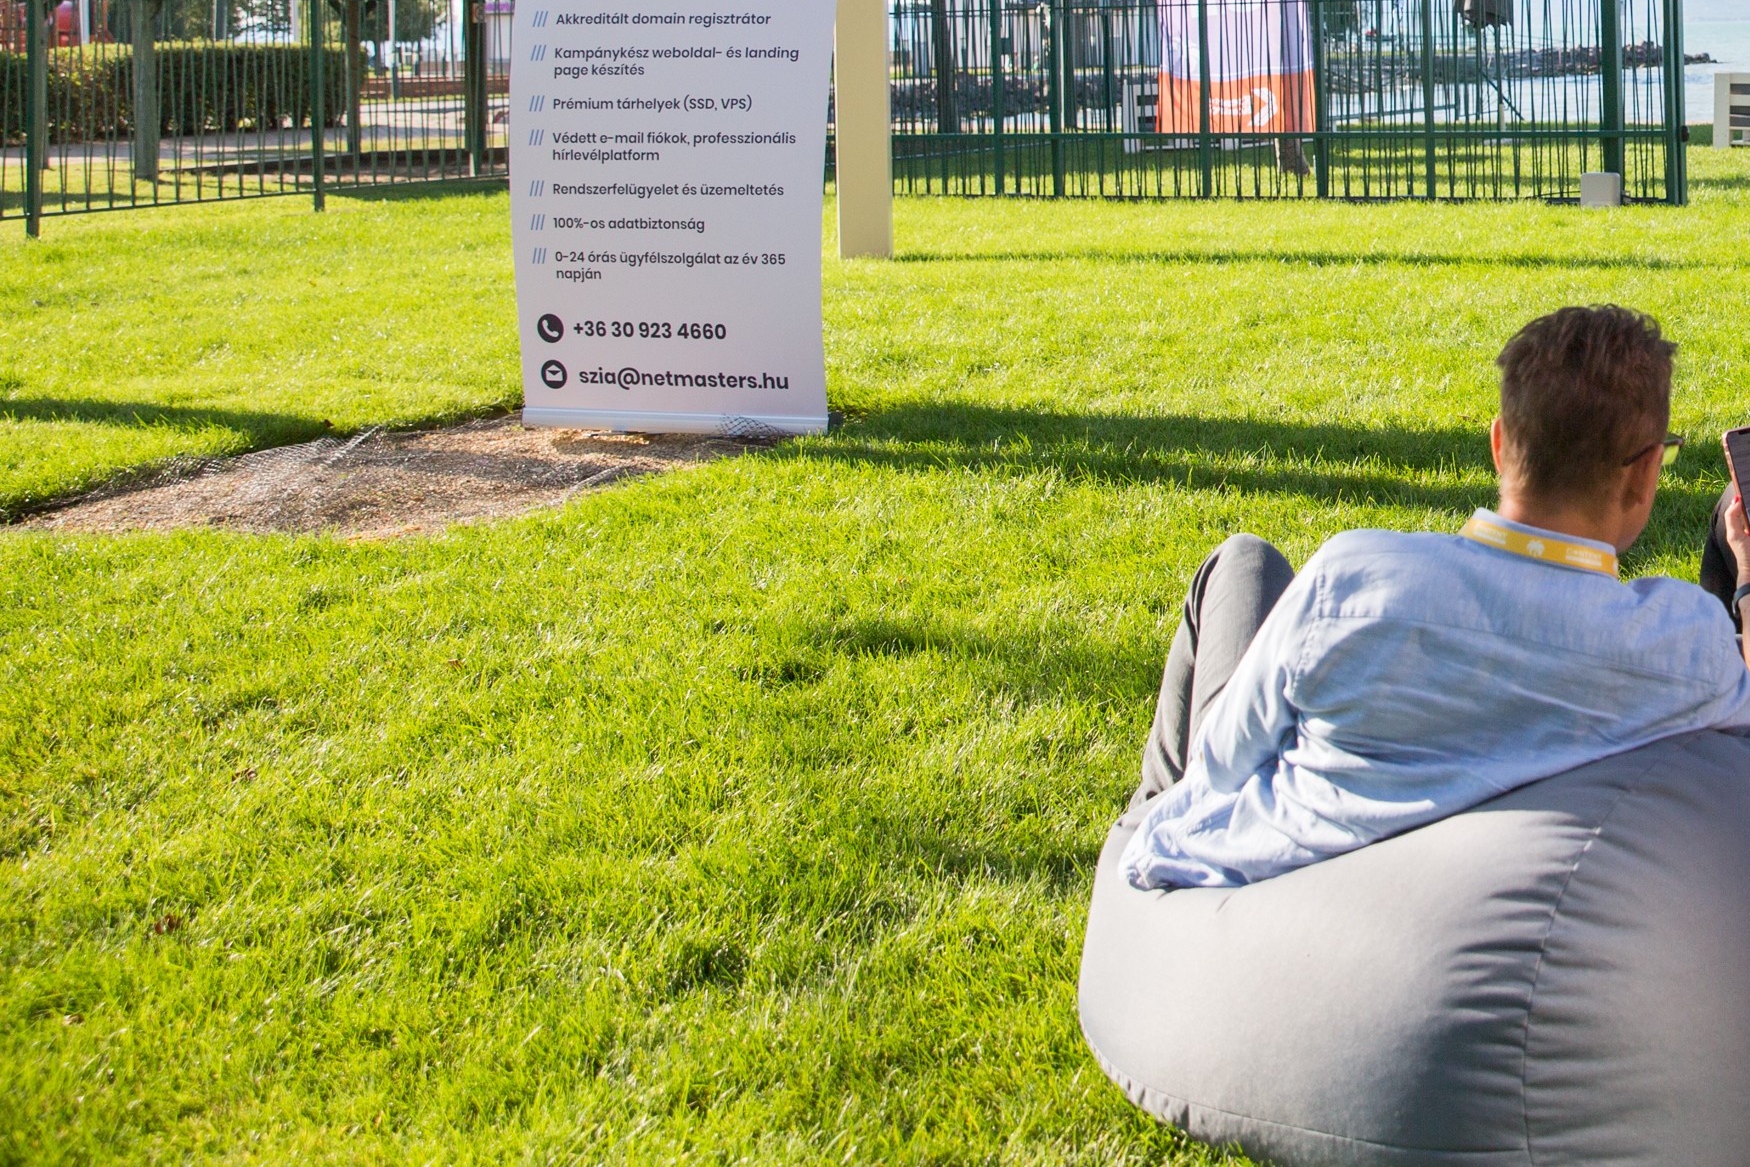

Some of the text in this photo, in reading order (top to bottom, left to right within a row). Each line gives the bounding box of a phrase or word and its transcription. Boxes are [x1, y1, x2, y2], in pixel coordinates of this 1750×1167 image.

[556, 12, 772, 28] Akkreditált domain regisztrátor
[554, 46, 800, 62] Kampánykész weboldal- és landing
[554, 63, 645, 79] page készítés
[553, 94, 753, 113] Prémium tárhelyek (SSD, VPS)
[552, 131, 797, 147] Védett e-mail fiókok, professzionális
[552, 149, 660, 164] hírlevélplatform
[553, 183, 785, 199] Rendszerfelügyelet és üzemeltetés
[553, 217, 706, 233] 100%-os adatbiztonság
[554, 251, 786, 267] 0-24 órás ügyfélszolgálat az év 365
[555, 268, 602, 282] napján
[573, 320, 727, 340] +36 30 923 4660
[579, 367, 789, 390] szia@netmasters.hu
